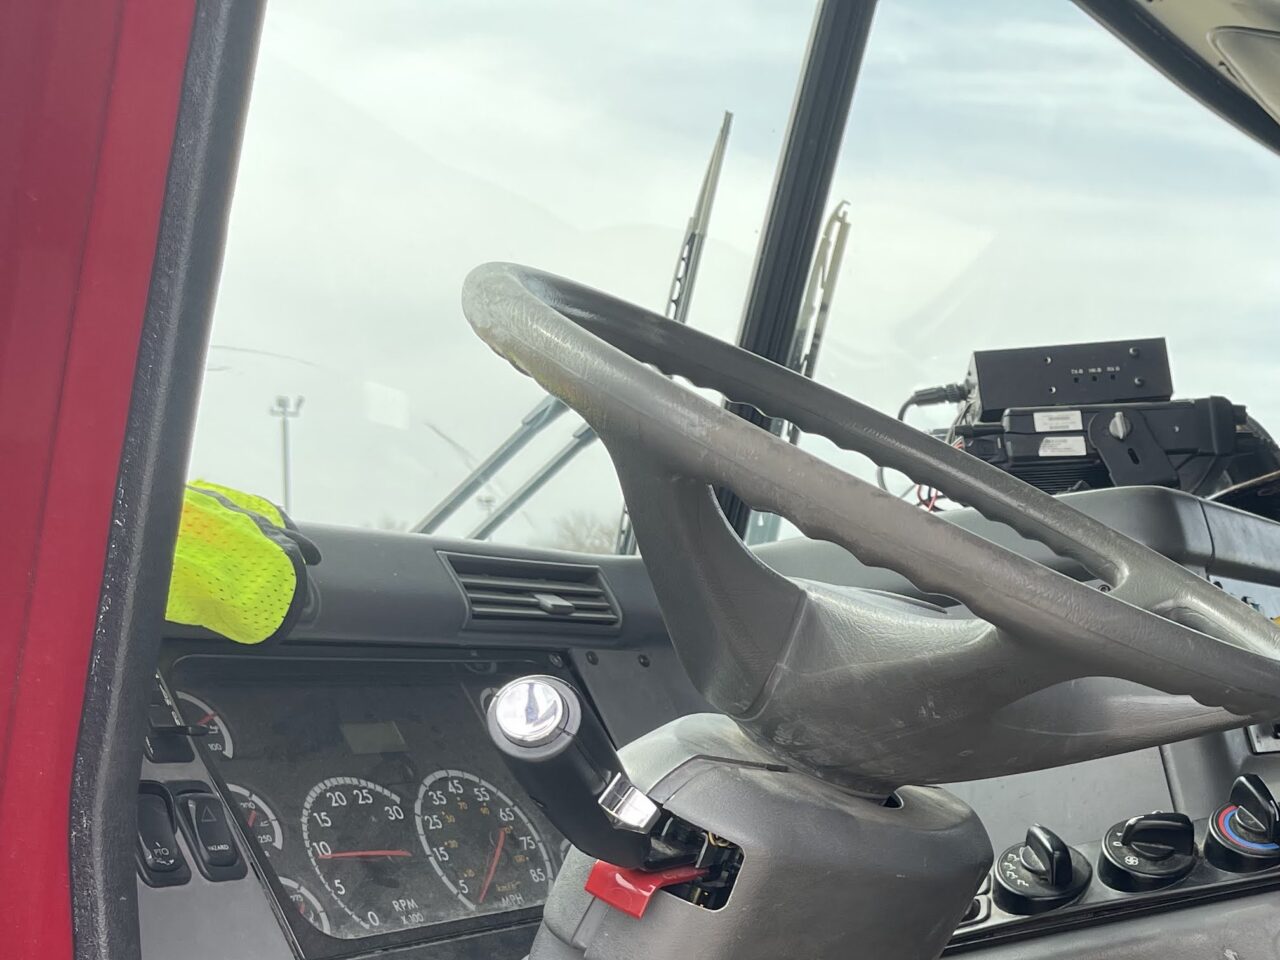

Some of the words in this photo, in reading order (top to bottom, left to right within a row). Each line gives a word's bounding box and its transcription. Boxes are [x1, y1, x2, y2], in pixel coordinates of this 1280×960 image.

[449, 779, 464, 795] 45
[473, 787, 490, 802] 55
[326, 791, 347, 807] 20
[353, 789, 373, 804] 25
[428, 791, 447, 805] 35
[313, 812, 332, 827] 15
[384, 806, 404, 820] 30
[499, 807, 515, 822] 65
[424, 814, 443, 830] 25
[313, 841, 331, 856] 10
[519, 836, 536, 850] 75
[432, 847, 449, 862] 15
[529, 868, 546, 883] 85
[334, 879, 346, 895] 5
[458, 880, 469, 894] 5
[392, 899, 418, 912] RPM
[501, 893, 525, 906] MPH
[367, 911, 380, 926] 0
